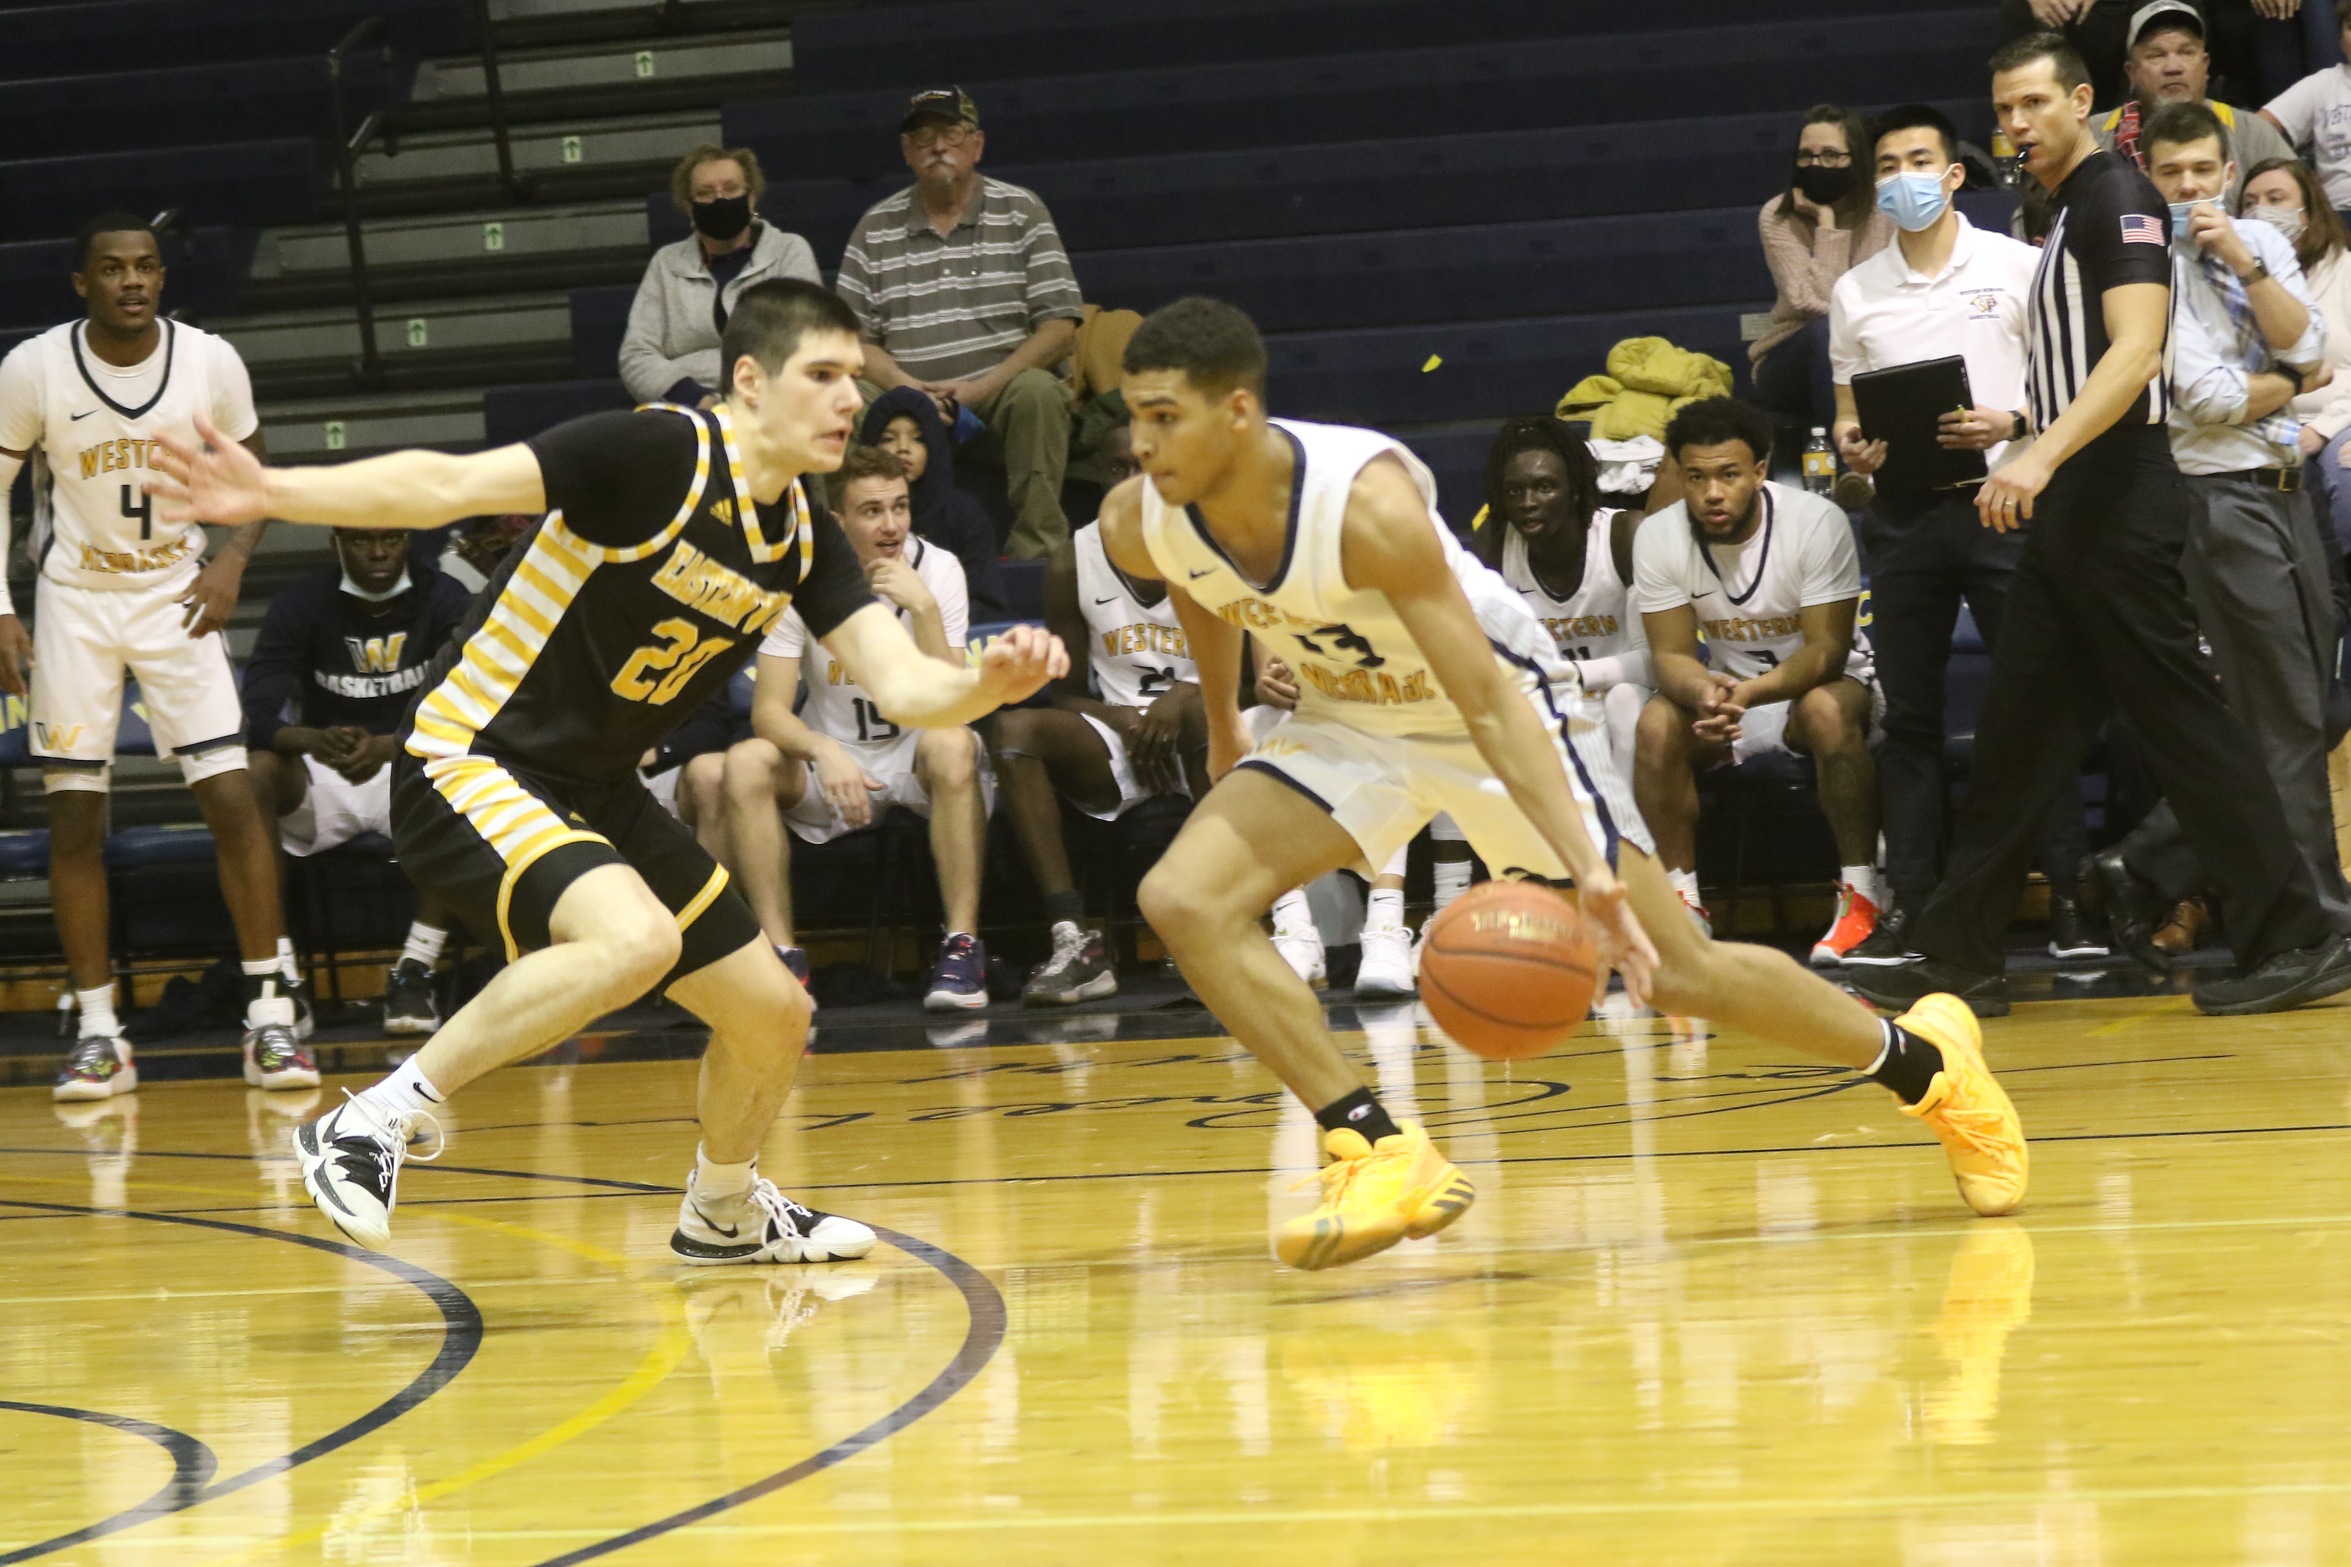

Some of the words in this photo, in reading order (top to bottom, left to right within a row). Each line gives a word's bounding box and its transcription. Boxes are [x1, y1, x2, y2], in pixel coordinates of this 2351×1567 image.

[121, 484, 152, 540] 4
[610, 617, 735, 705] 20
[1103, 623, 1192, 659] WESTER
